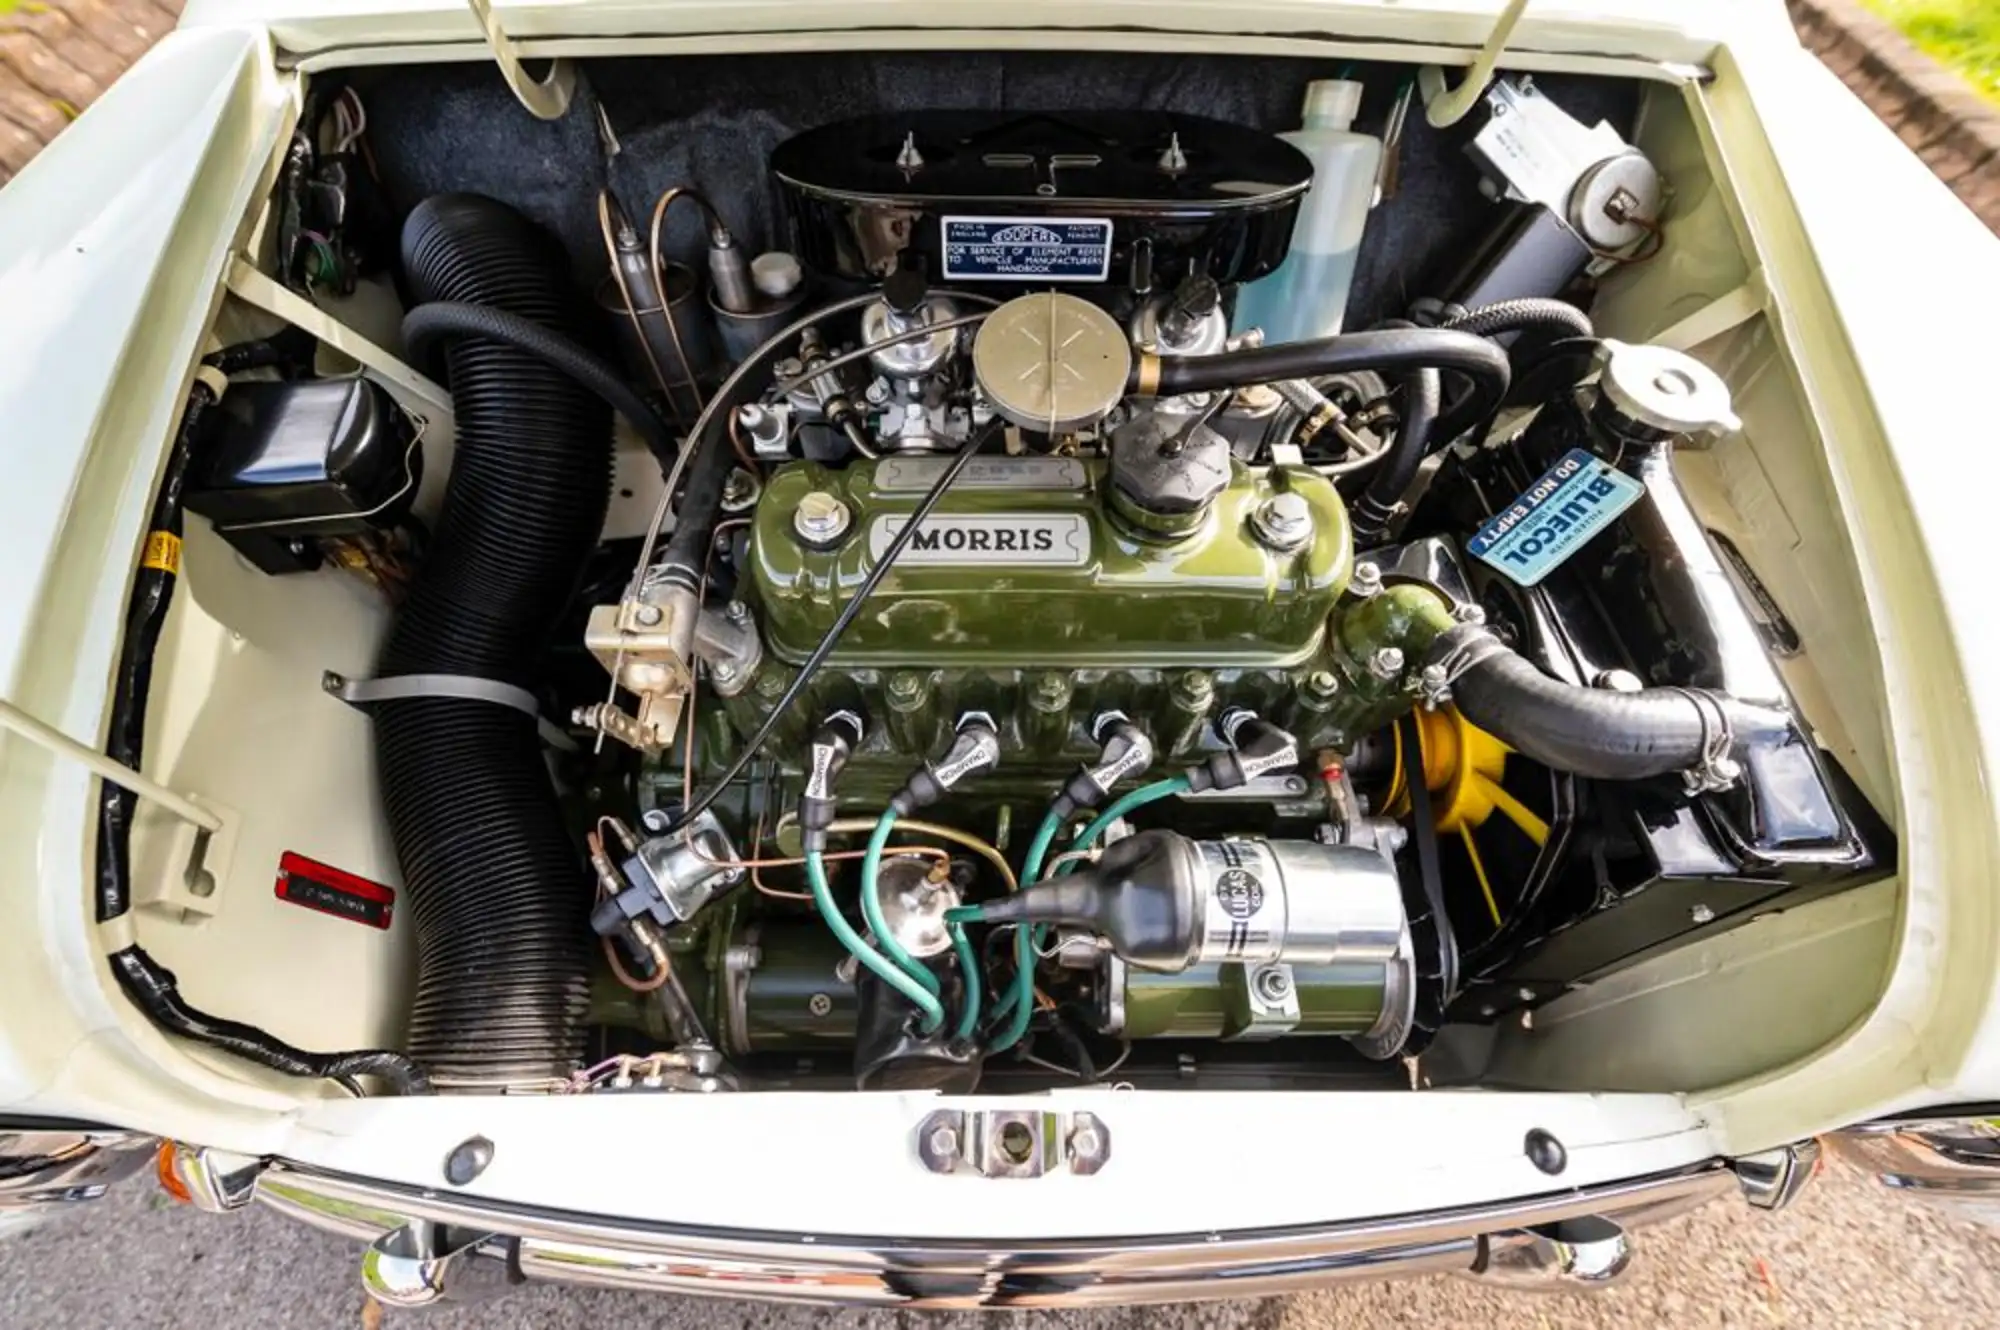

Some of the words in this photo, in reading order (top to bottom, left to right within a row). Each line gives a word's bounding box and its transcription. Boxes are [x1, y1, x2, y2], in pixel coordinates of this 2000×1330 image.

[946, 245, 966, 255] FOR
[970, 246, 1005, 256] SERVICE
[1011, 246, 1025, 256] OF
[1031, 247, 1071, 257] ELEMENT
[948, 255, 962, 264] TO
[975, 255, 1013, 265] VEHICLE
[1555, 458, 1581, 479] DO
[1527, 478, 1560, 507] NOT
[1478, 504, 1530, 549] EMPTY
[1503, 475, 1617, 566] BLUECOL
[911, 528, 1053, 551] MORRIS
[1228, 871, 1250, 917] LUCAS
